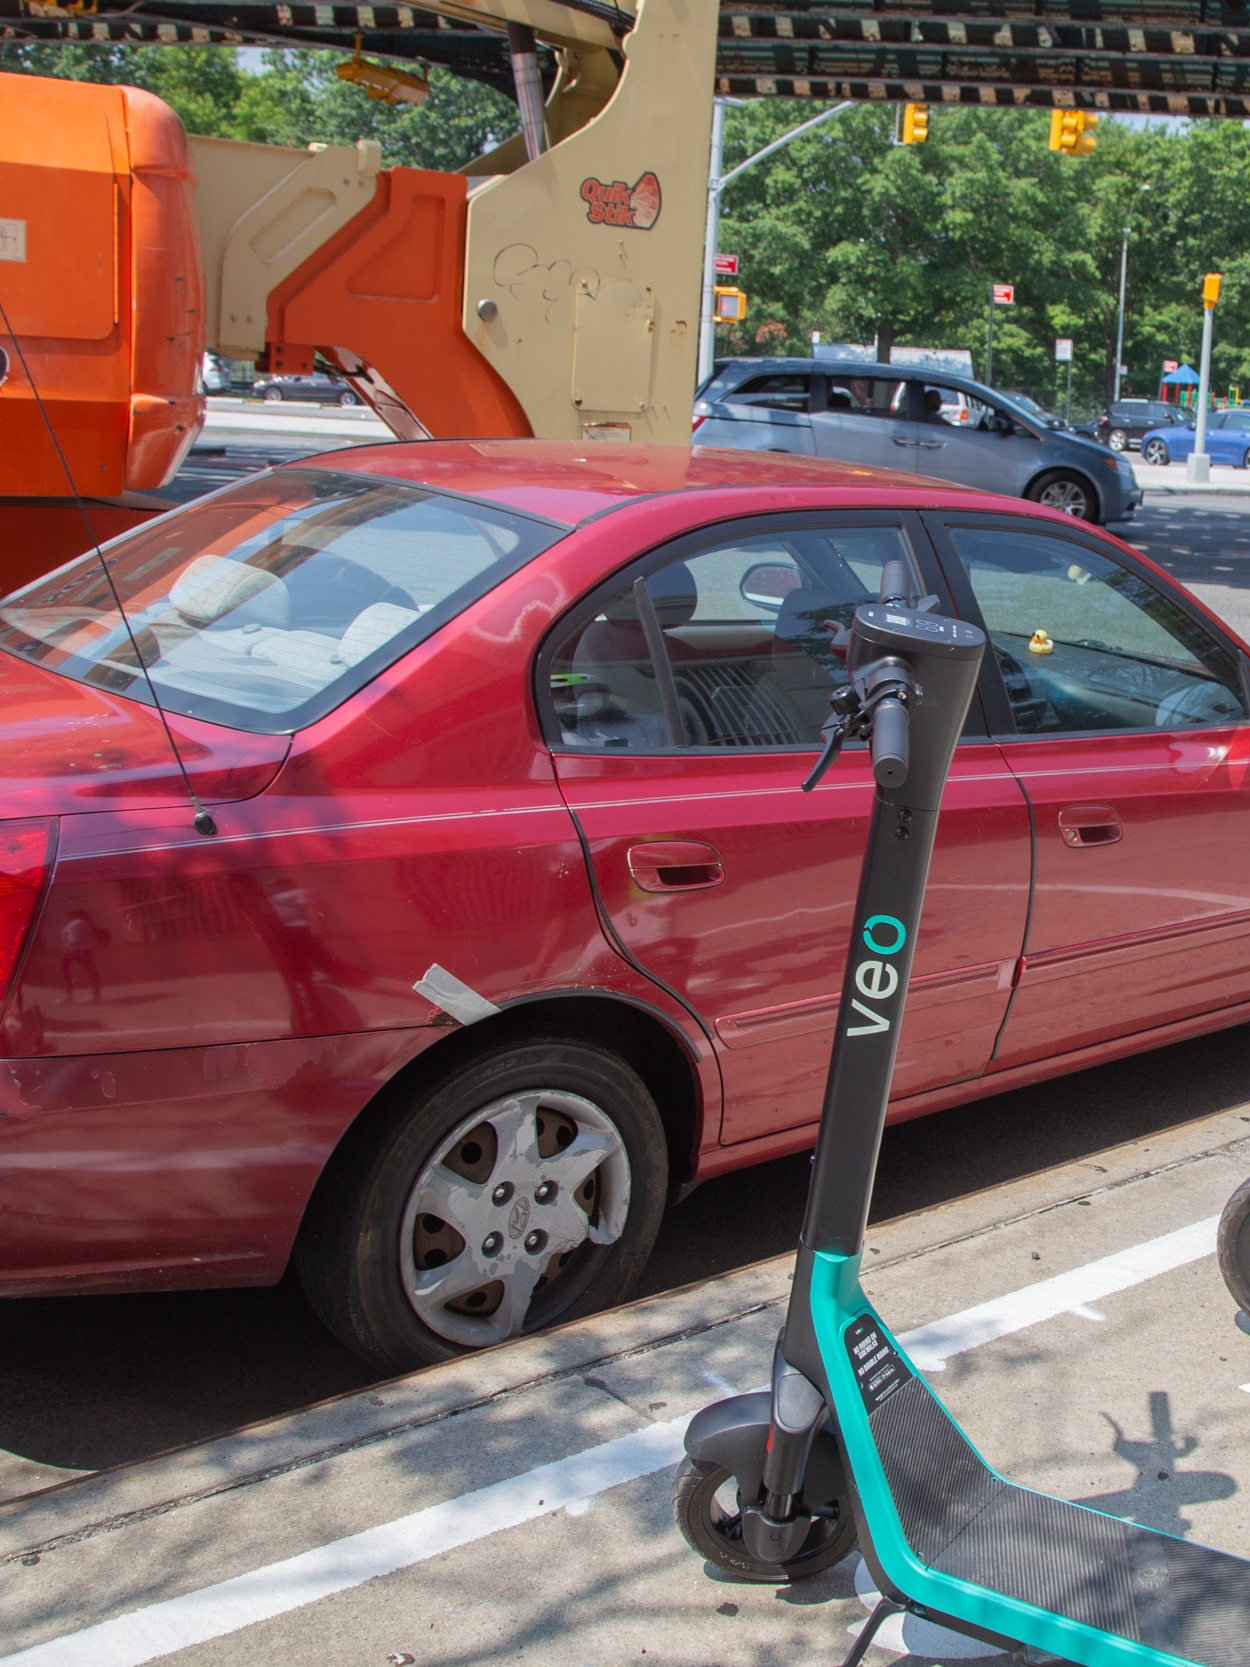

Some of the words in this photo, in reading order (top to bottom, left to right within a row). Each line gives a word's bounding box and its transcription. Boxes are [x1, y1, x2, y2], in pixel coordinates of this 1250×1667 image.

[580, 178, 633, 205] Quik
[588, 201, 636, 227] Stik
[846, 914, 907, 1037] veo
